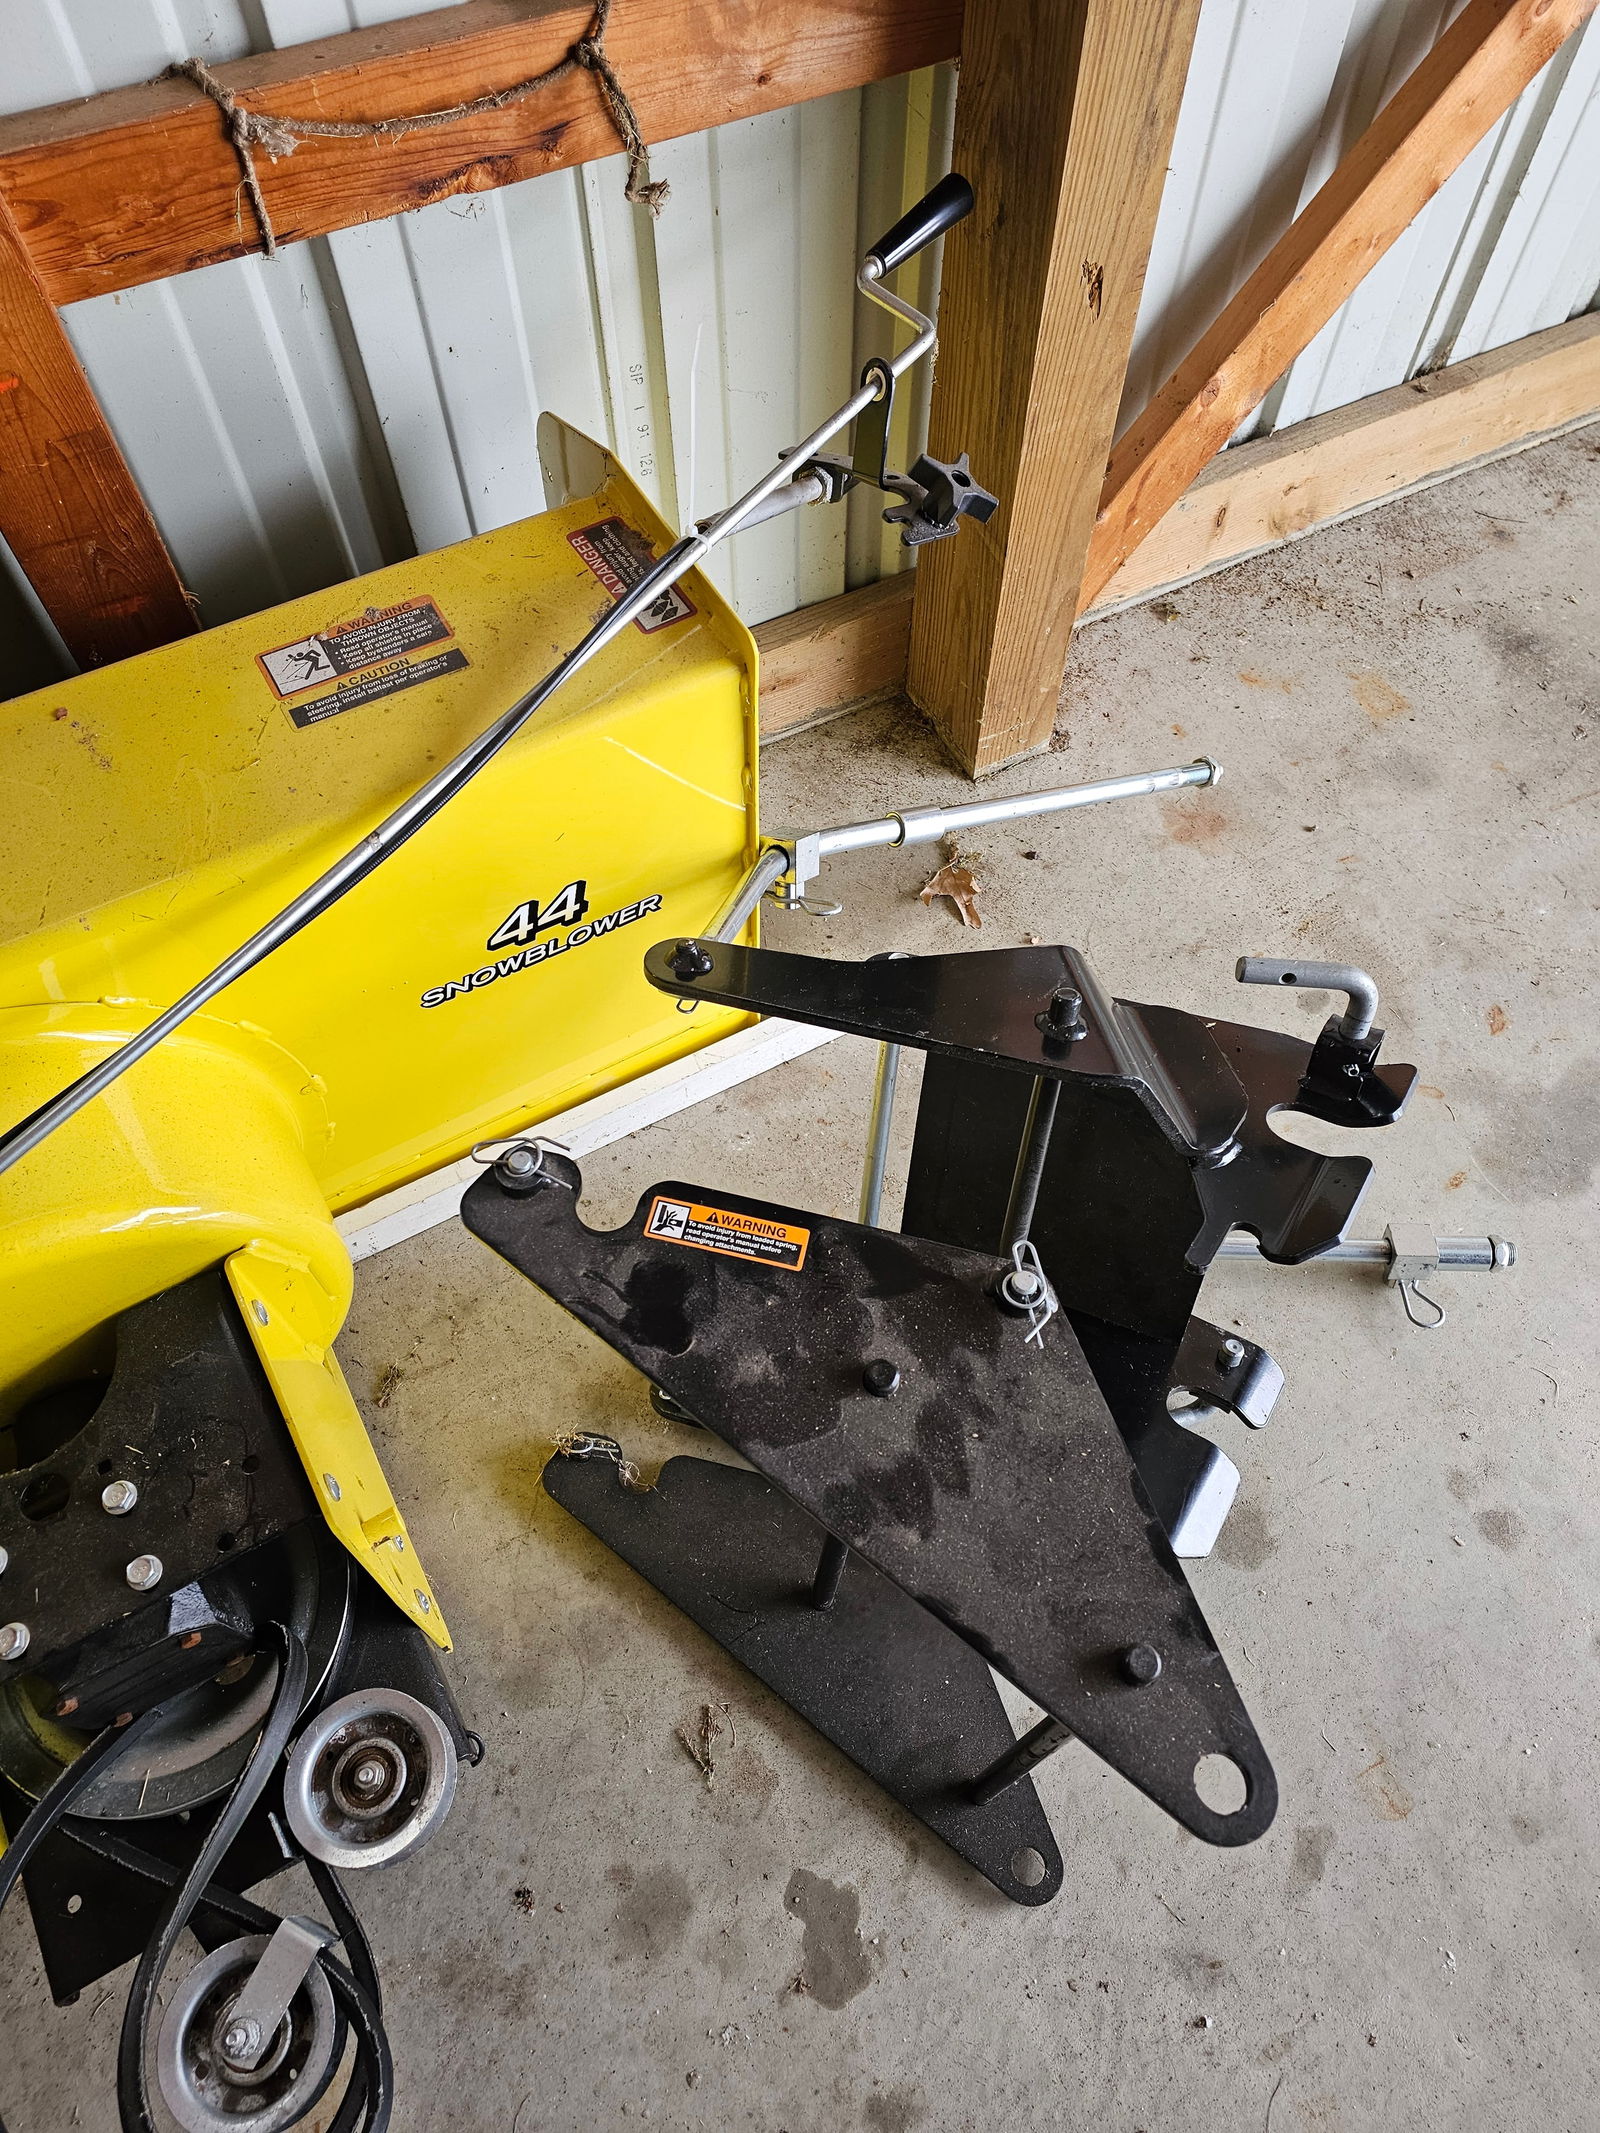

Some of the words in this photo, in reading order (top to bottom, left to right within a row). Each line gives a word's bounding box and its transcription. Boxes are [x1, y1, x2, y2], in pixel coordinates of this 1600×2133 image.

[629, 363, 644, 386] SIP
[594, 540, 607, 554] from
[602, 524, 622, 546] clothing
[602, 537, 615, 551] keep
[571, 535, 618, 585] DANGER
[605, 553, 620, 569] injury
[618, 546, 630, 557] and
[329, 637, 341, 645] TO
[342, 628, 367, 641] AVOID
[367, 617, 396, 631] INJURY
[397, 608, 421, 620] FROM
[348, 602, 412, 631] WANING
[340, 642, 360, 655] Read
[361, 629, 400, 648] operator's
[400, 619, 428, 633] manual
[341, 631, 377, 647] THROWN
[378, 616, 415, 634] OBJECTS
[342, 648, 363, 660] Keep
[364, 643, 374, 652] all
[375, 635, 403, 650] shields
[403, 631, 412, 639] in
[412, 623, 433, 637] place
[345, 653, 366, 665] Keep
[366, 637, 409, 659] bystanders
[349, 654, 381, 670] distance
[382, 646, 403, 661] away
[303, 703, 315, 712] To
[316, 694, 338, 707] avoid
[338, 686, 361, 701] injury
[361, 680, 382, 692] from
[381, 673, 399, 683] loss
[399, 668, 408, 677] of
[408, 659, 439, 675] braking
[440, 654, 448, 663] or
[348, 657, 411, 686] CAUTION
[307, 702, 343, 718] steering,
[342, 690, 367, 703] install
[367, 681, 395, 695] ballast
[394, 675, 408, 686] per
[409, 661, 448, 681] operator's
[309, 708, 340, 723] manual
[487, 879, 589, 951] 44
[420, 894, 663, 1008] SNOWBLOWER
[688, 1220, 698, 1228] To
[698, 1222, 716, 1232] avoid
[716, 1226, 736, 1237] injury
[736, 1230, 752, 1240] from
[752, 1234, 775, 1245] loaded
[721, 1214, 787, 1239] WARNING
[683, 1234, 714, 1247] changing
[714, 1241, 756, 1256] attachments.
[685, 1228, 701, 1237] read
[702, 1231, 735, 1243] operator's
[735, 1238, 760, 1249] manual
[760, 1244, 782, 1254] before
